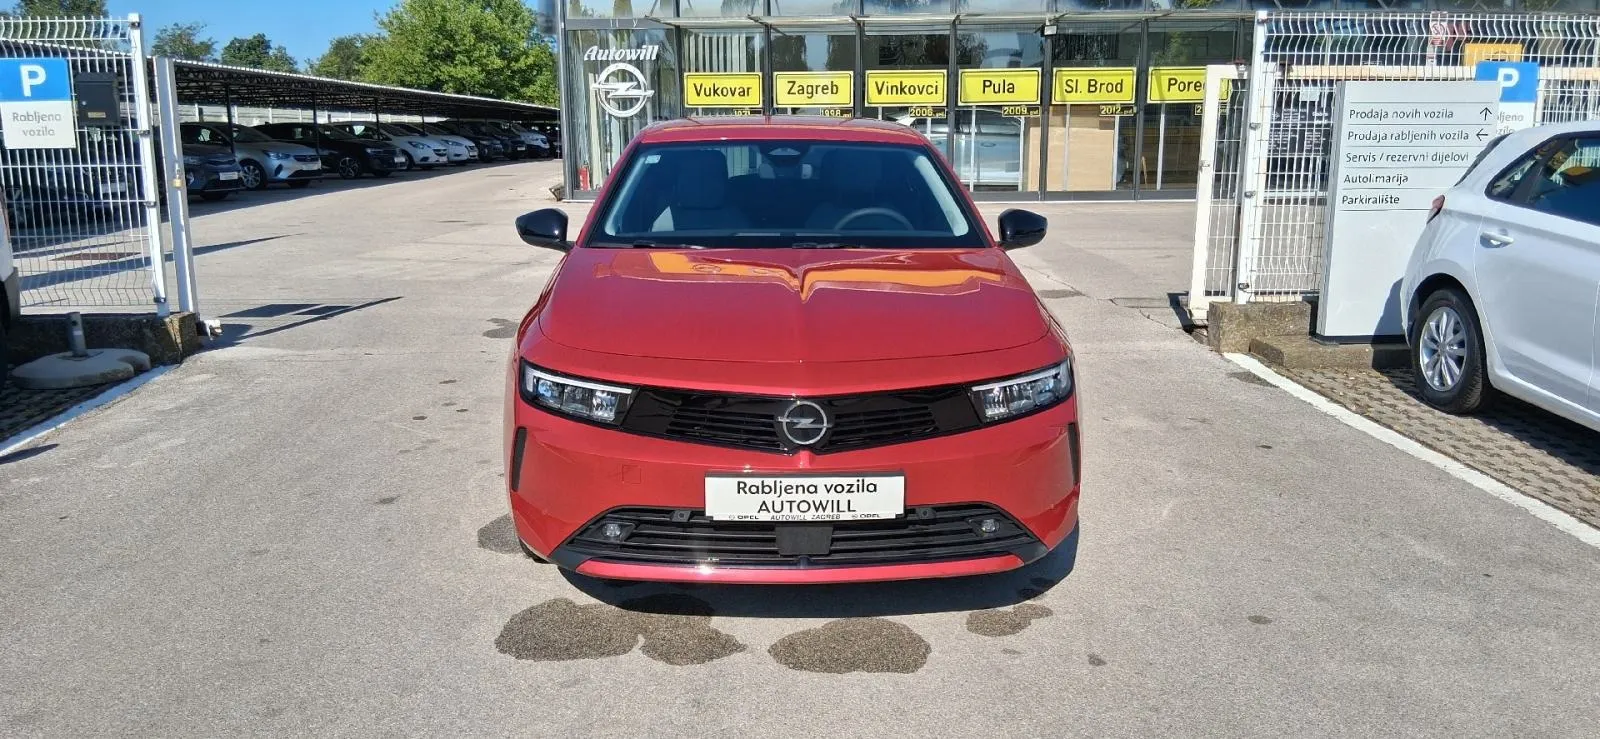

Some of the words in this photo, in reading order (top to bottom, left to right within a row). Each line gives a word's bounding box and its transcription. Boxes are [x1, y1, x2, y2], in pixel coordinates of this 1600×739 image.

[584, 45, 659, 61] Autowill
[20, 64, 47, 97] P
[982, 79, 1015, 94] Pula
[1064, 79, 1083, 94] Sl.
[1087, 78, 1124, 94] Brod
[693, 83, 752, 97] Vukovar
[787, 81, 839, 99] Zagreb
[875, 81, 939, 96] Vinkovci
[1349, 108, 1389, 121] Prodaja
[1392, 108, 1421, 119] novih
[1424, 108, 1454, 119] vozila
[1347, 131, 1388, 143] Prodaja
[1390, 131, 1437, 143] rabljenih
[1439, 130, 1469, 141] vozila
[1346, 152, 1376, 163] Servis
[1386, 153, 1429, 162] rezervni
[1431, 151, 1469, 165] dijelovi
[1342, 195, 1400, 205] Parkiralište
[737, 480, 818, 498] Rabljena
[824, 479, 878, 494] vozila
[757, 499, 857, 514] AUTOWILL
